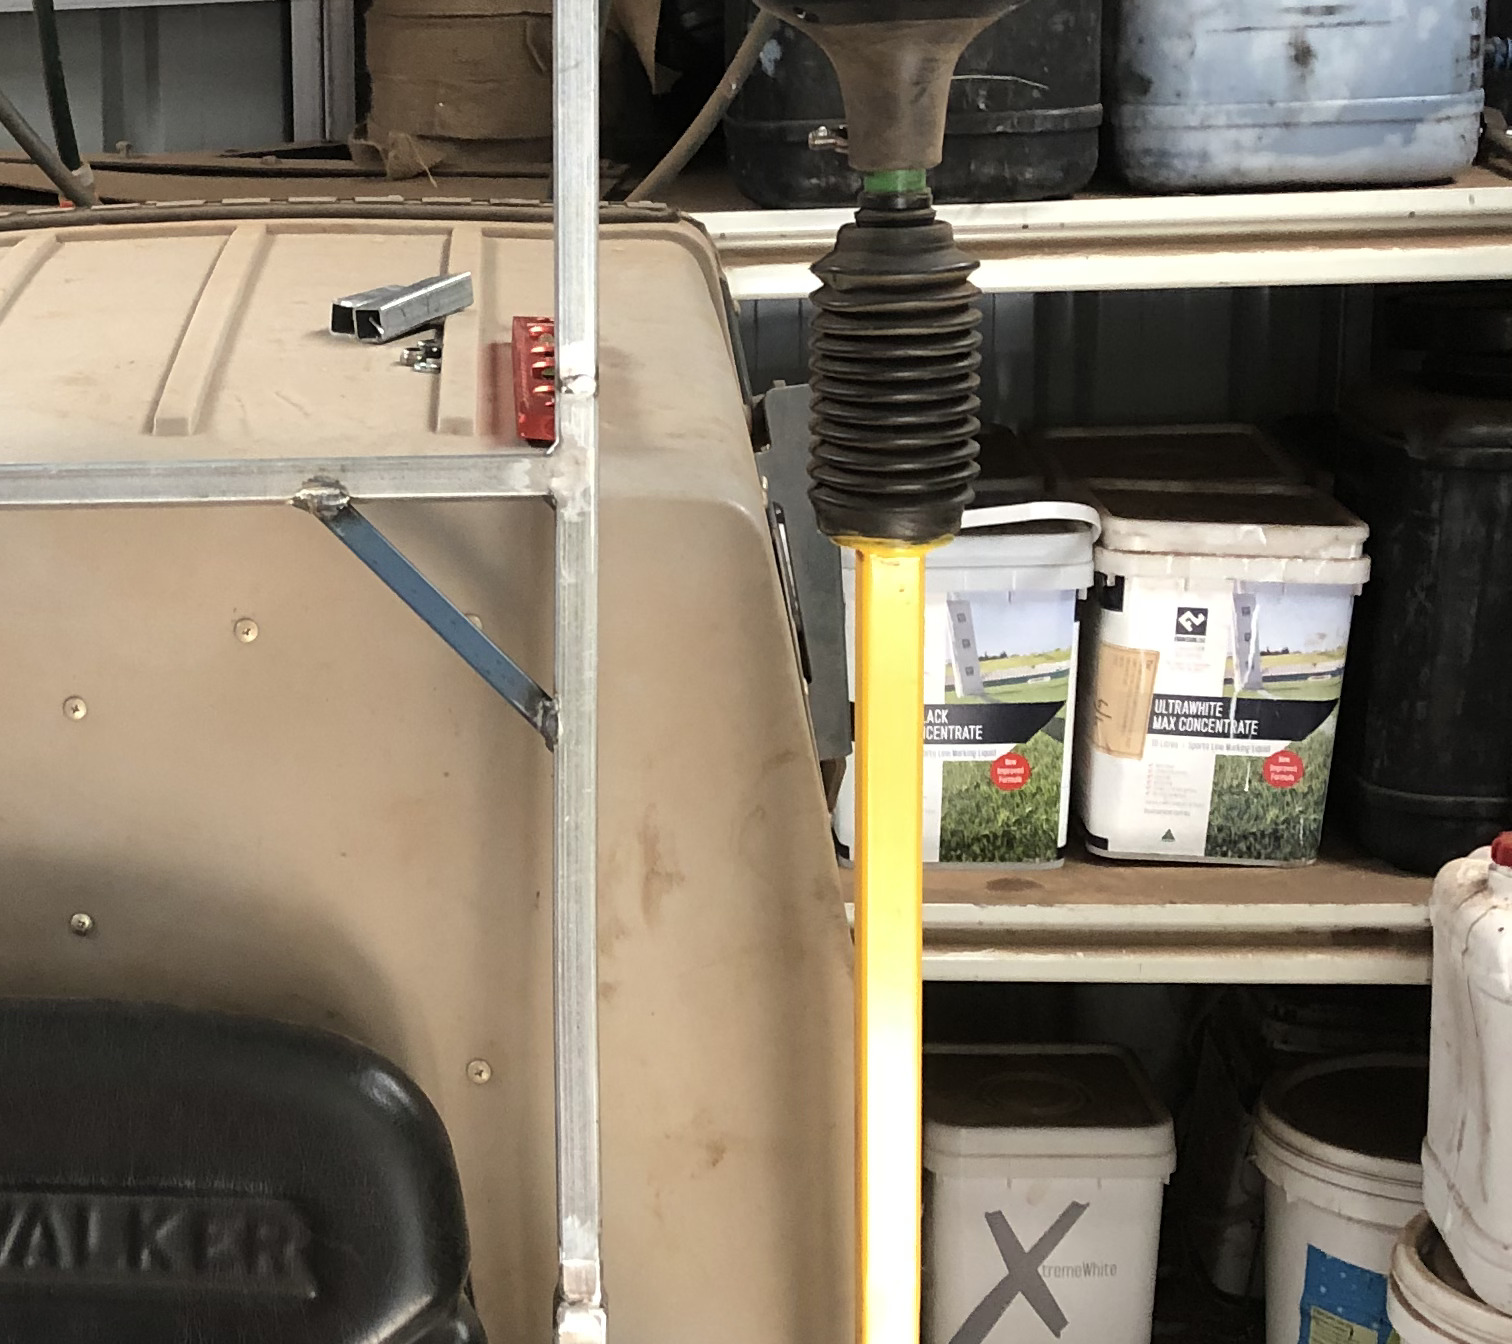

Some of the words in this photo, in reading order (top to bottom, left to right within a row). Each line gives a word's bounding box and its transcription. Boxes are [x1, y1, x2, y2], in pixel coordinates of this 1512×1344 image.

[1155, 698, 1224, 717] ULTRAWHITE
[1152, 716, 1175, 731] MAX
[1178, 718, 1259, 736] CONCENTRATE
